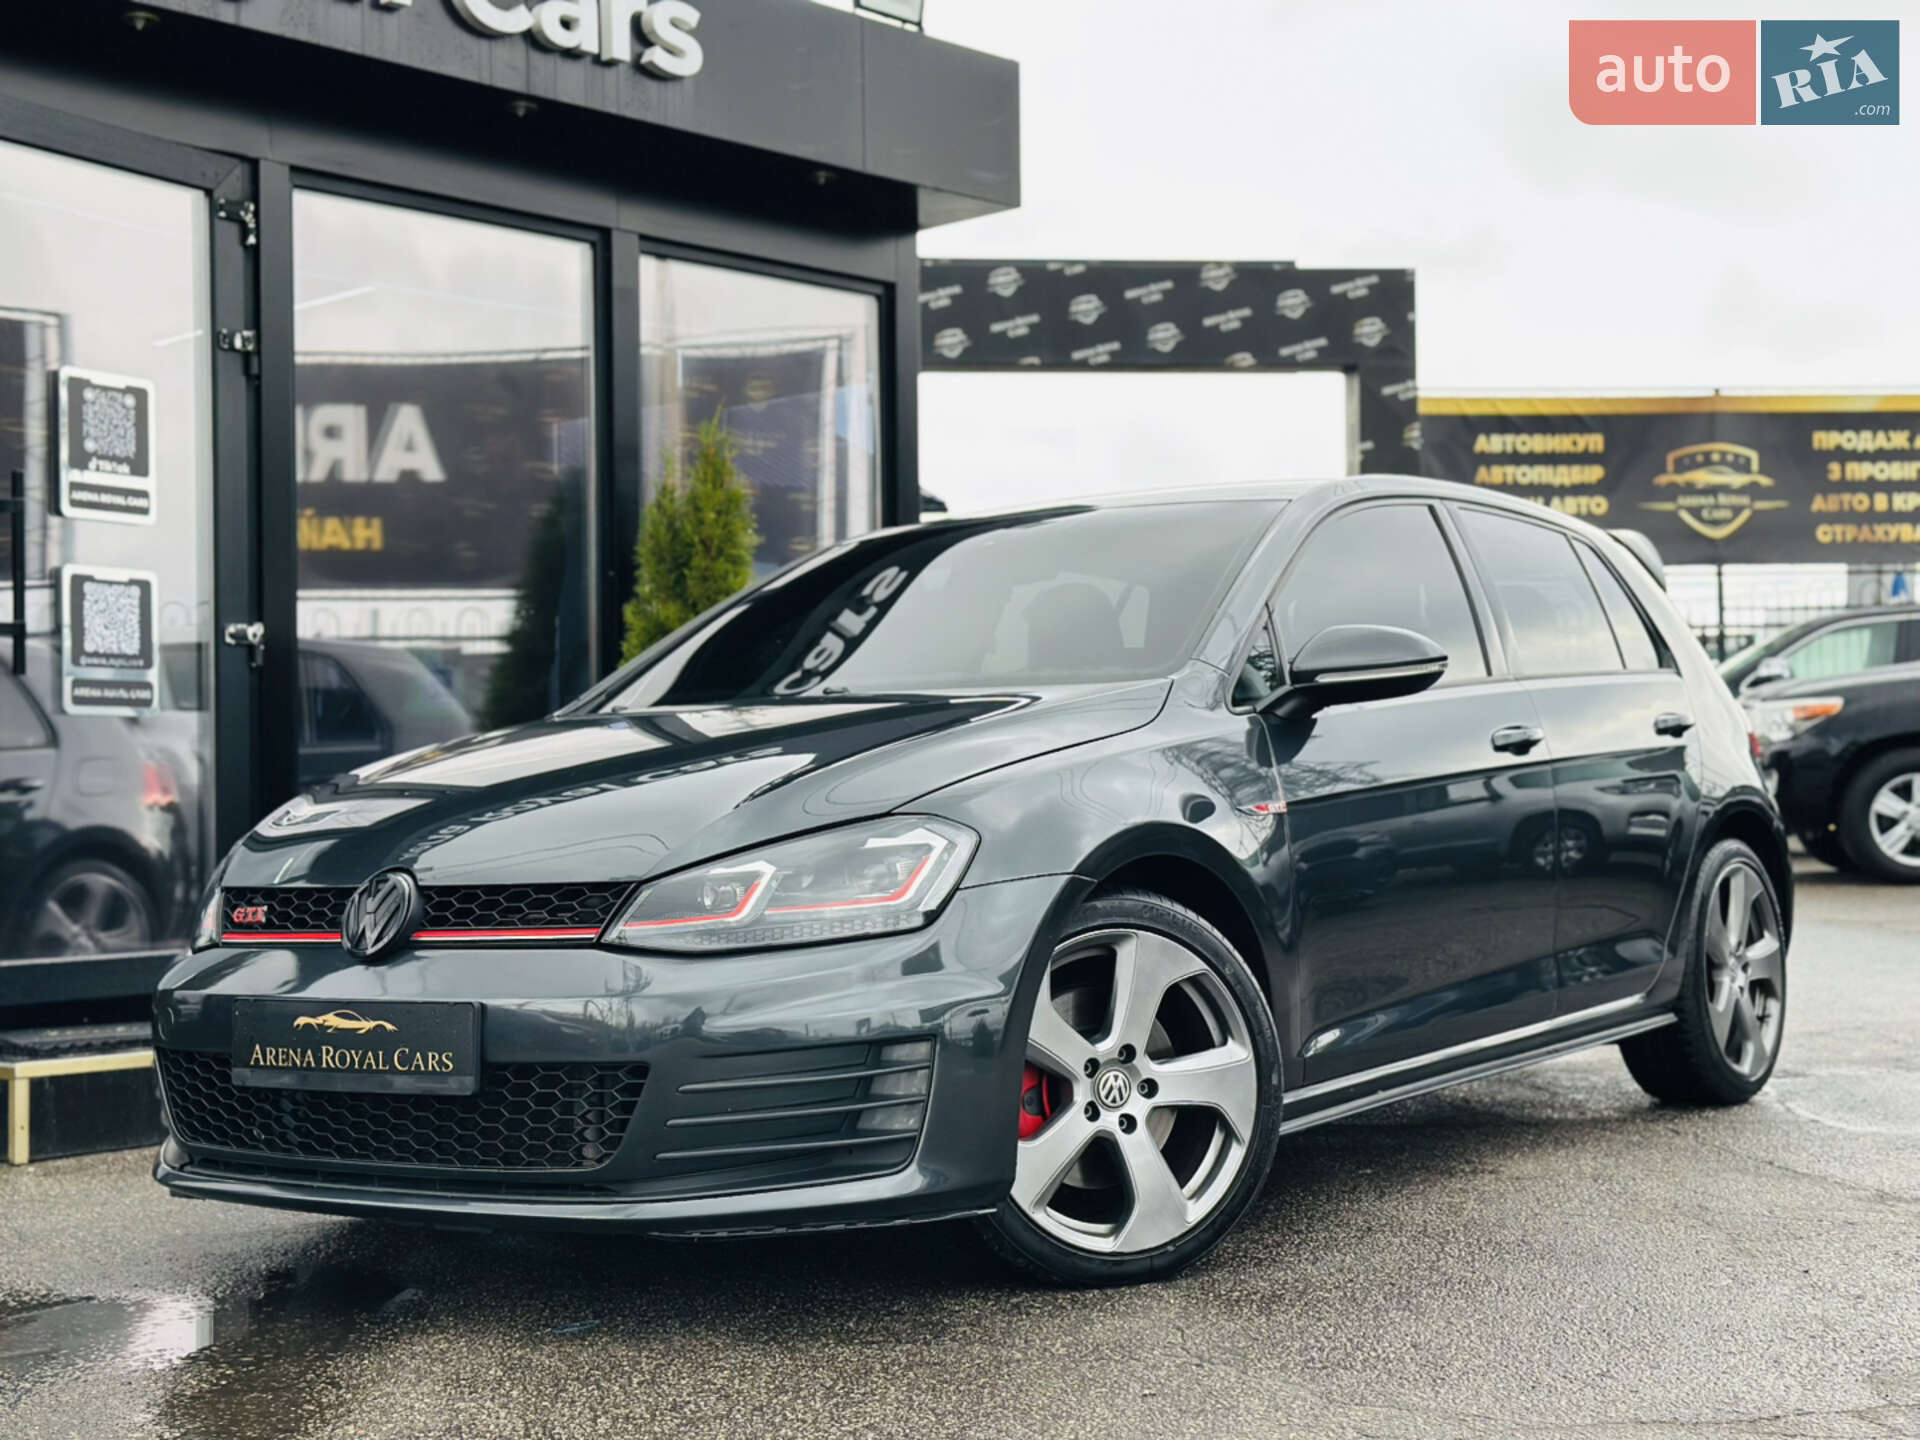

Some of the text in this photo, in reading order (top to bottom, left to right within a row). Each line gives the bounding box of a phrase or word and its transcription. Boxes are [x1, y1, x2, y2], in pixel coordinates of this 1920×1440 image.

[1812, 429, 1911, 453] ПРОДАЖ
[1549, 496, 1610, 517] АВТО
[1810, 492, 1871, 514] АВТО
[232, 906, 267, 924] GTI
[250, 1043, 455, 1073] ARENA ROYAL CARS
